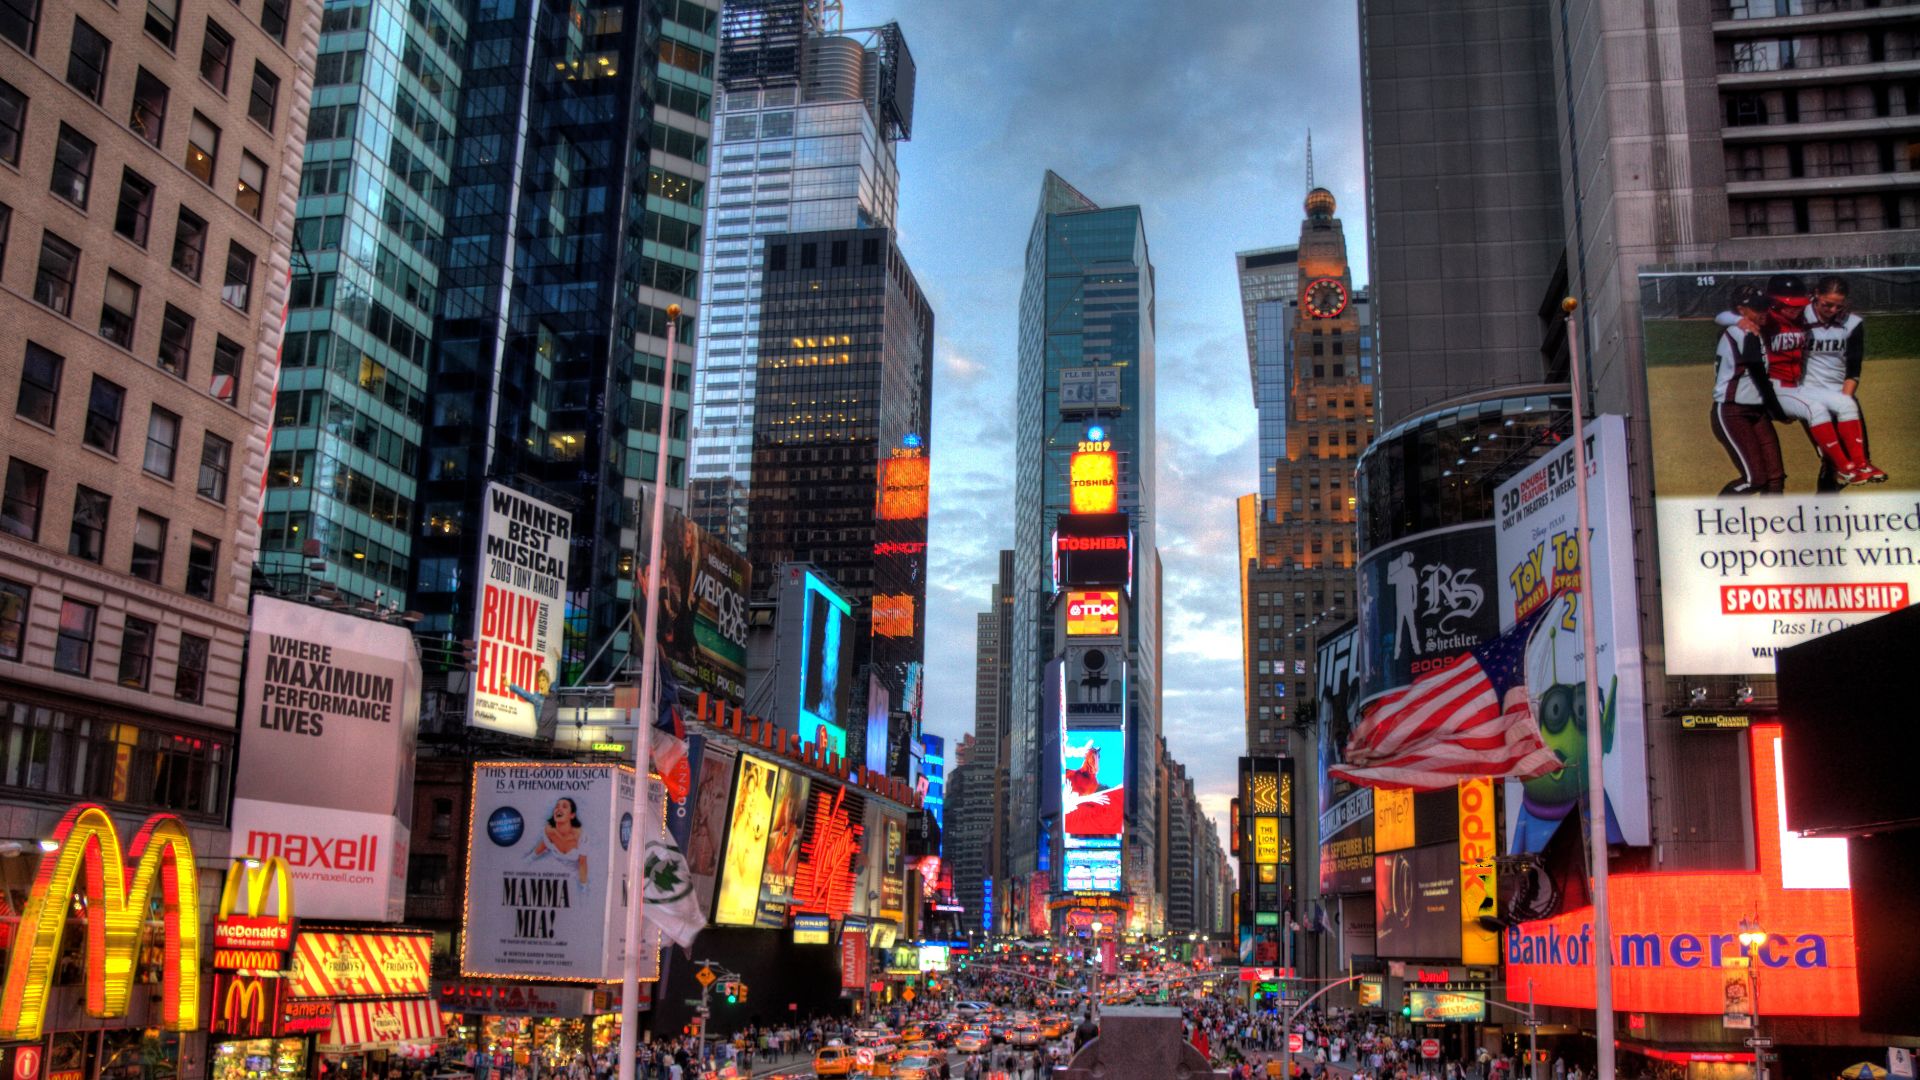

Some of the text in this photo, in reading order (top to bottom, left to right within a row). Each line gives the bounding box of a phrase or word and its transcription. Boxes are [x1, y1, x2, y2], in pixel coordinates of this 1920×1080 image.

[1697, 276, 1715, 286] 215
[1809, 338, 1846, 352] ENTRA
[1078, 441, 1110, 452] 2009
[1073, 479, 1115, 487] TOSHIBA
[1501, 433, 1595, 516] 3D DOUBLE EVET
[1521, 480, 1548, 504] FEATURE
[492, 488, 570, 540] WINNER
[1502, 516, 1514, 531] ONLY
[1515, 511, 1522, 524] IN
[1523, 493, 1549, 519] THEATRES
[1550, 490, 1555, 502] 2
[1695, 502, 1920, 542] Helped injured
[508, 520, 551, 553] BEST
[1058, 537, 1127, 550] TOSHIBA
[486, 534, 565, 580] MUSICAL
[1510, 540, 1545, 600] TOY
[1700, 538, 1920, 576] opponent win.
[490, 558, 559, 600] 2009 TONY AWARD
[693, 570, 745, 620] MELROSE
[1080, 604, 1114, 616] TDK
[1517, 586, 1545, 618] STORY
[1726, 586, 1904, 611] SPORTSMANSHIP
[481, 584, 539, 650] BILLY
[1561, 590, 1577, 632] 2
[536, 602, 549, 653] THE MUSICAL
[718, 606, 747, 648] PLACE
[1426, 627, 1437, 638] By
[1772, 618, 1857, 635] Pass It O
[269, 634, 332, 664] WHERE
[1425, 634, 1478, 652] Sheckler
[265, 654, 394, 703] MAXIMUM
[477, 639, 545, 703] ELLIOT
[263, 683, 392, 723] PERFORMANCE
[1068, 703, 1121, 714] CHEVROLET
[260, 704, 324, 737] LIVES
[496, 779, 594, 792] IS A PHENOMENON!"
[509, 767, 564, 779] FEEL-GOOD
[567, 767, 610, 779] MUSICAL
[1379, 798, 1410, 828] smile?
[247, 830, 378, 872] maxell
[1331, 838, 1362, 854] SEPTEMBER
[1364, 836, 1373, 853] 19
[291, 870, 374, 885] ww.maxell.com
[1338, 854, 1373, 872] PAY-PER-VIEW
[502, 877, 570, 908] MAMMA
[216, 925, 287, 939] McDonald's
[514, 909, 555, 939] MIA!
[227, 938, 274, 947] Restaurant
[1508, 924, 1829, 968] Bank of merca
[329, 961, 360, 972] FRIDAY'S
[386, 961, 415, 972] FRIDAY'S
[442, 983, 539, 999] DIGITAL
[1409, 982, 1486, 991] MARQUIS
